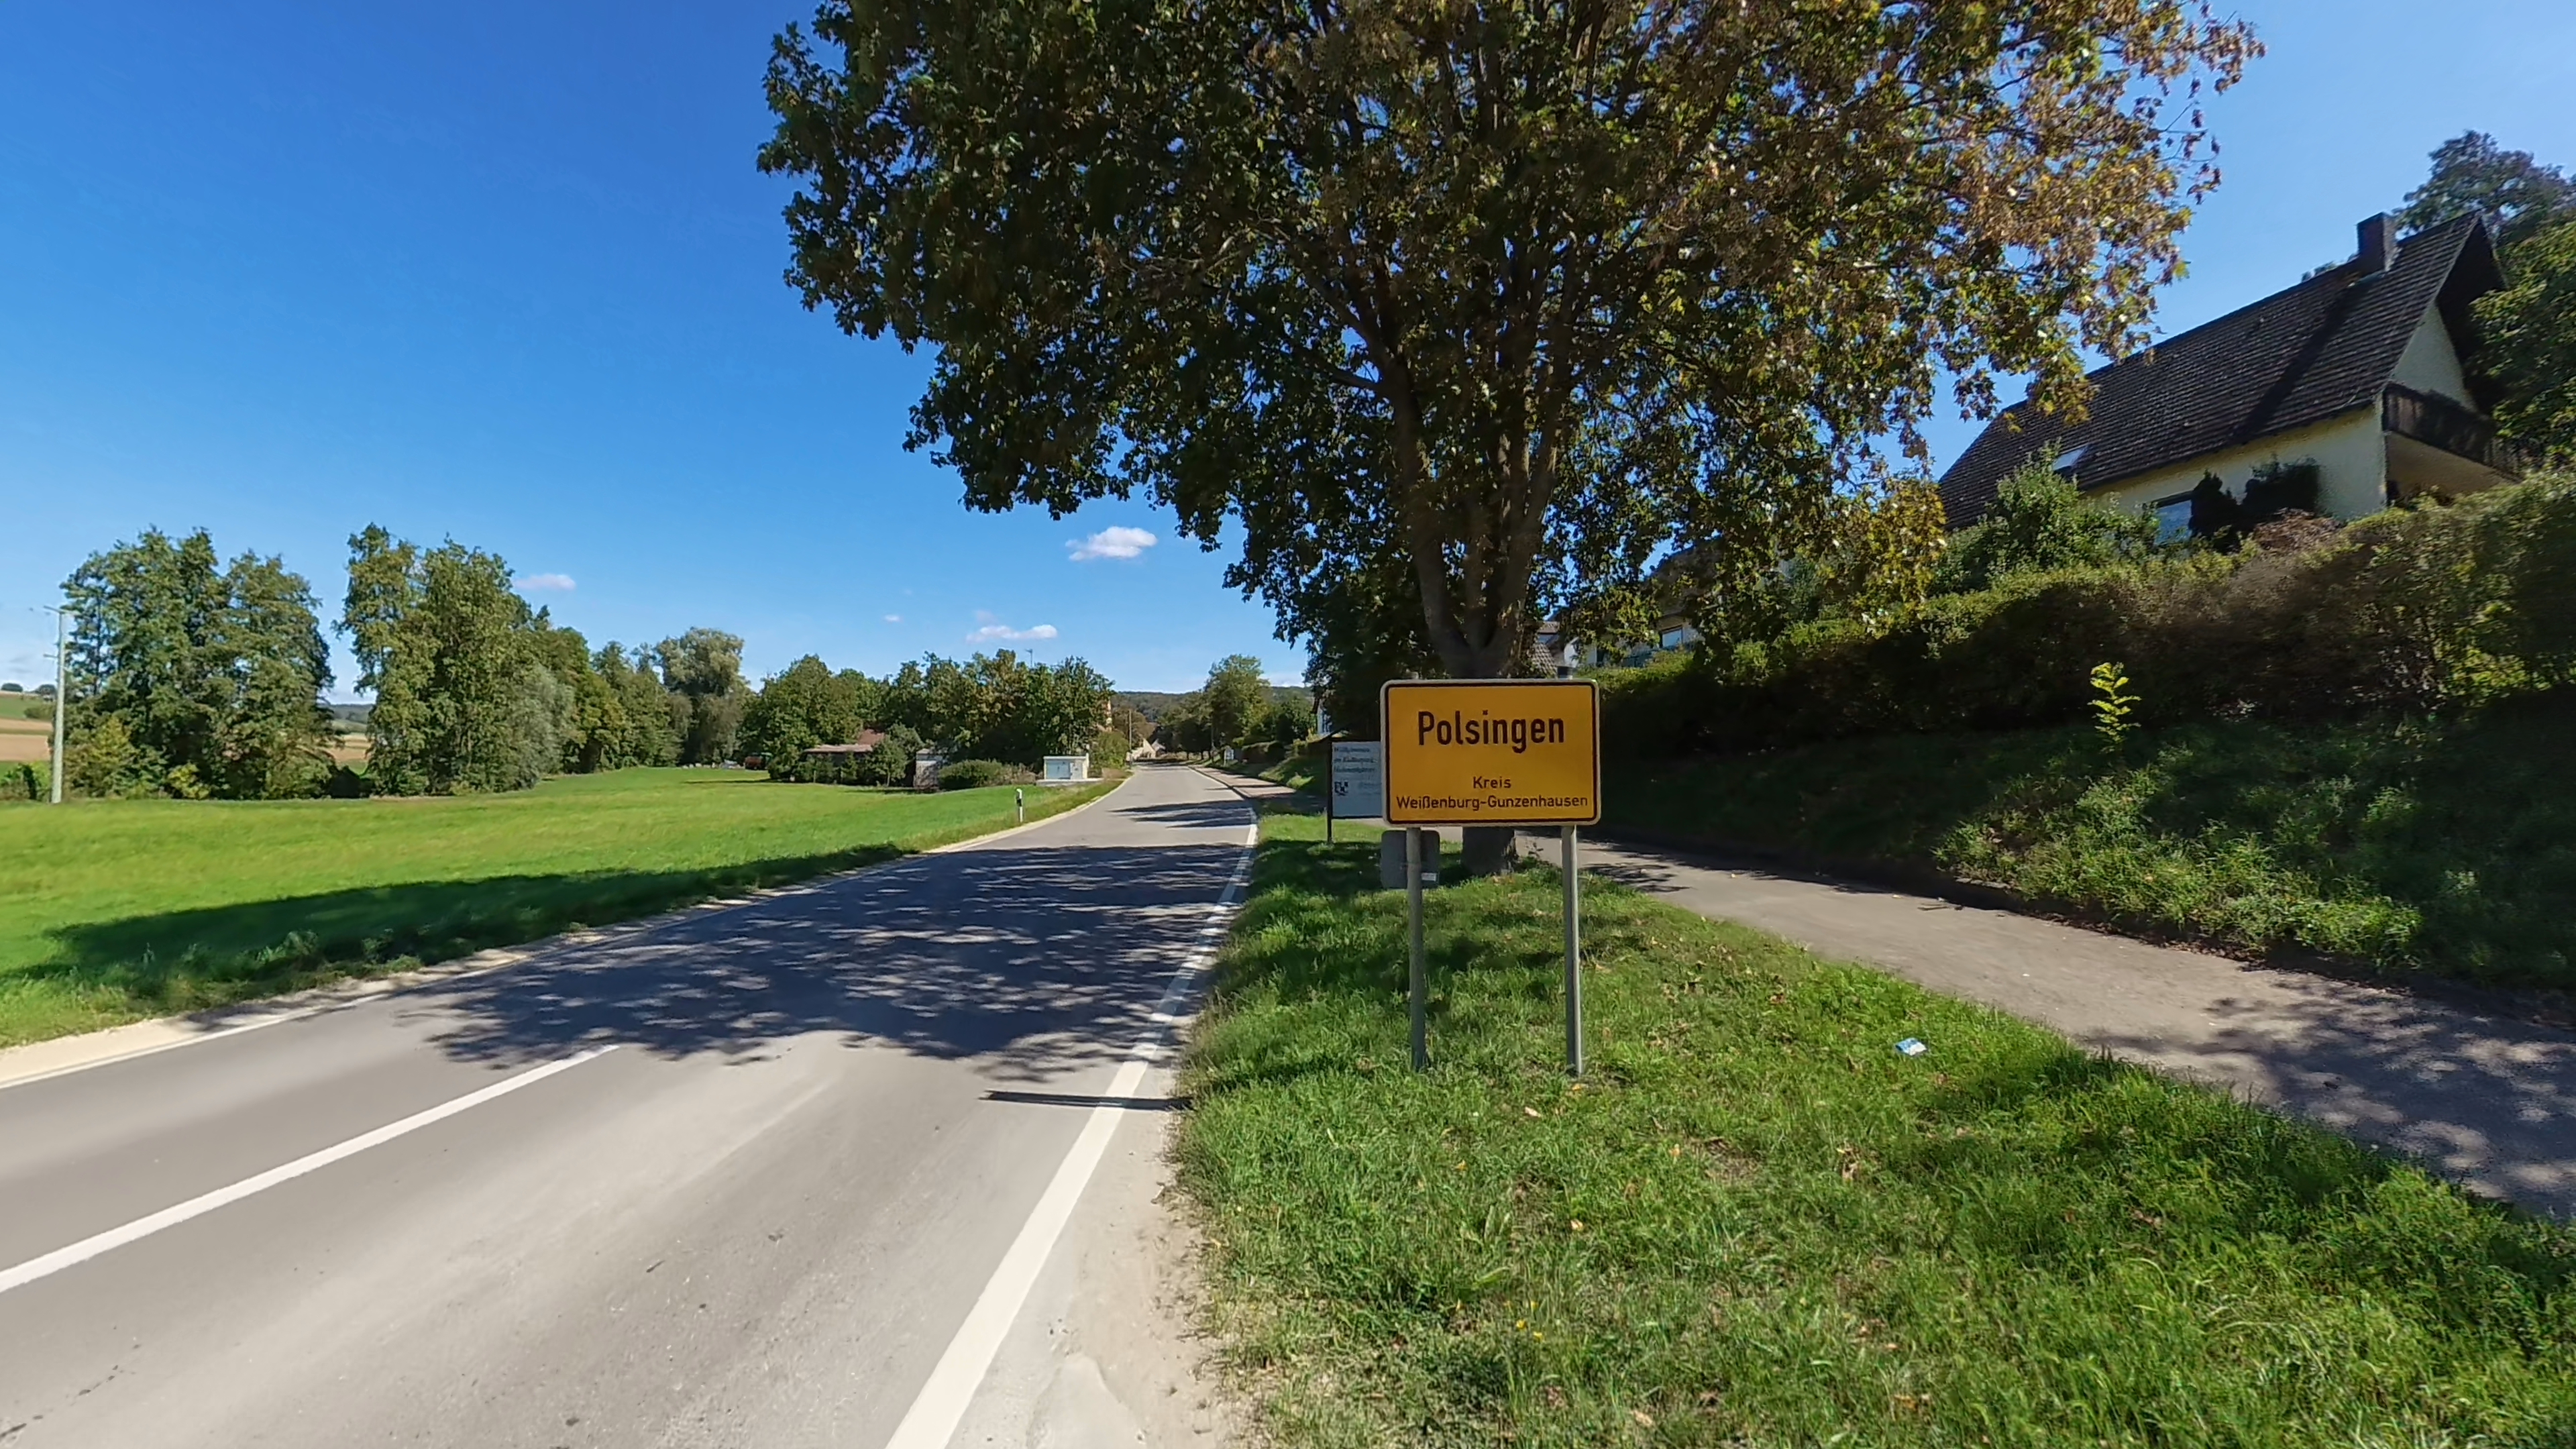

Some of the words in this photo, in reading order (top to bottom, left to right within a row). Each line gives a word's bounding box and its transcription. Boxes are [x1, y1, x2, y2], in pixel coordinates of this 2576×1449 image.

[1418, 710, 1564, 753] Polsingen
[1473, 776, 1511, 788] Kreis
[1396, 794, 1588, 811] Weißenburg-Gunzenhausen
